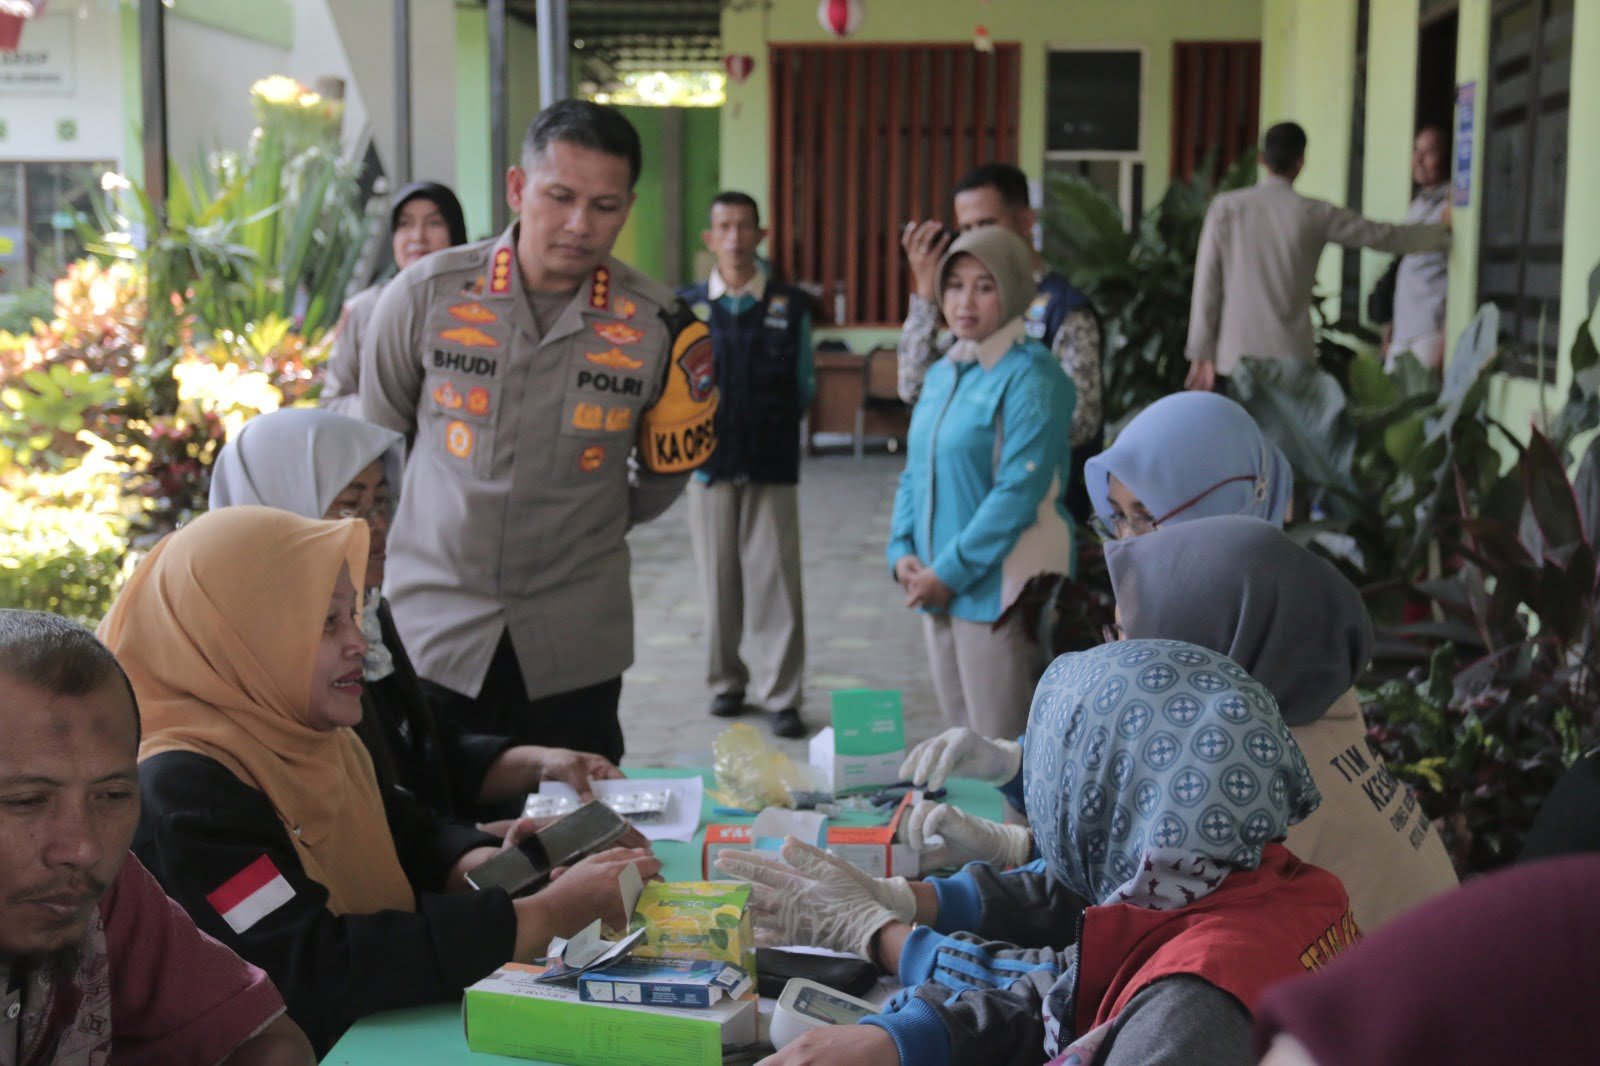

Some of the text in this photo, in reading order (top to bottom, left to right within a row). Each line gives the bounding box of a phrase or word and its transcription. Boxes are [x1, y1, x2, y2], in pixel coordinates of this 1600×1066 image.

[433, 350, 497, 377] BHUDI
[577, 371, 643, 397] POLRI
[655, 431, 682, 465] KA
